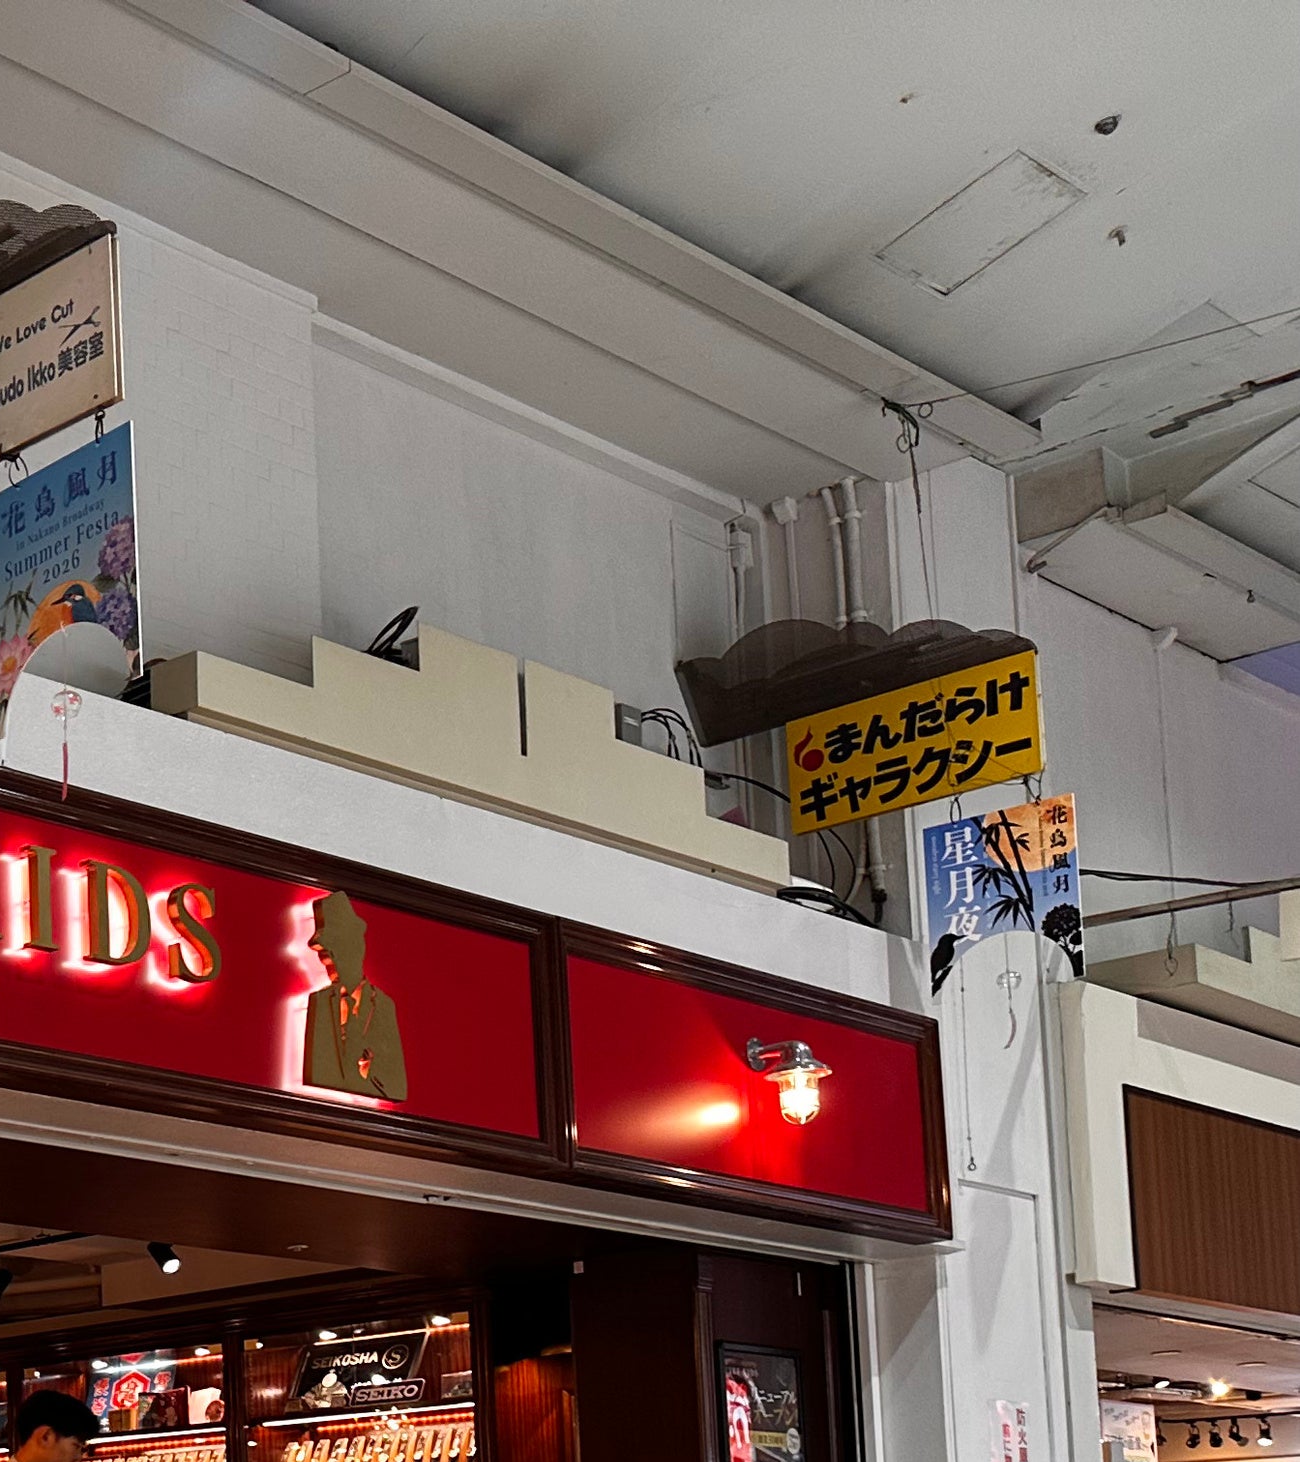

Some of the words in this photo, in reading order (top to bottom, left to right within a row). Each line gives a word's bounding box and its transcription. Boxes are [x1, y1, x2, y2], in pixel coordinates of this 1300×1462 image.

[16, 317, 47, 344] Love
[51, 298, 74, 323] Cut
[27, 361, 56, 392] Ikko
[58, 331, 104, 378] 美容室
[1, 451, 117, 539] 花鳥風月
[28, 522, 60, 542] Nakano
[62, 498, 106, 528] Broadway
[4, 535, 70, 582] Summer
[76, 511, 119, 546] Festa
[43, 549, 80, 584] 2026
[823, 671, 1030, 765] まんだらけ
[799, 737, 1033, 823] ギャラクシー
[1047, 804, 1071, 894] 花鳥風月
[941, 826, 983, 946] 星月夜
[311, 1351, 379, 1369] SEIKOSHA
[355, 1384, 419, 1402] SEIKO
